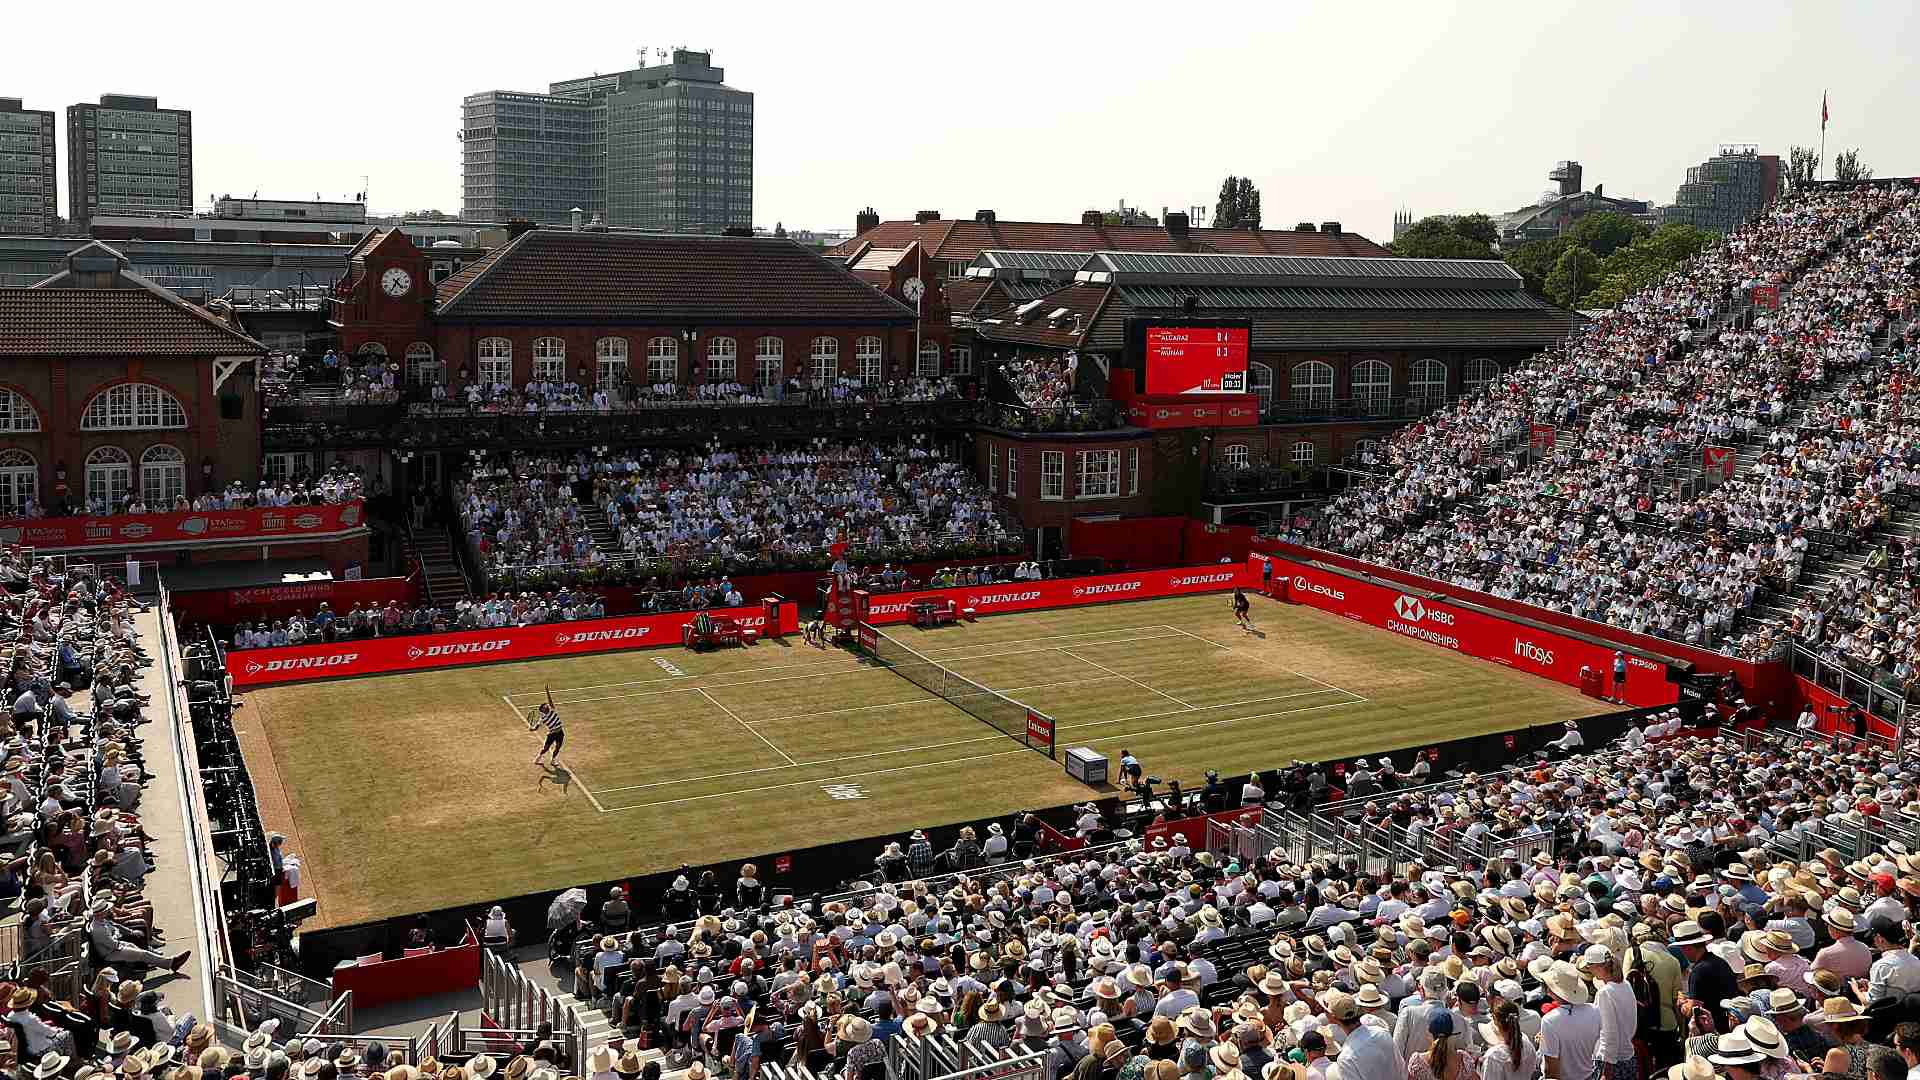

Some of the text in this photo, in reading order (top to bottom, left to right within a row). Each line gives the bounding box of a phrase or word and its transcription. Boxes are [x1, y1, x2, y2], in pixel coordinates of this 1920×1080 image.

[1085, 581, 1142, 594] DUNLOP
[1182, 573, 1234, 585] DUNLOP
[981, 591, 1041, 604] DUNLOP
[1307, 582, 1345, 600] LEXUS
[1427, 607, 1455, 626] HSBC
[572, 627, 650, 643] DUNLOP
[1387, 619, 1459, 649] CHAMPIONSHIPS
[424, 639, 513, 657] DUNLOP
[1513, 637, 1554, 665] Infosys
[265, 653, 360, 672] DUNLOP
